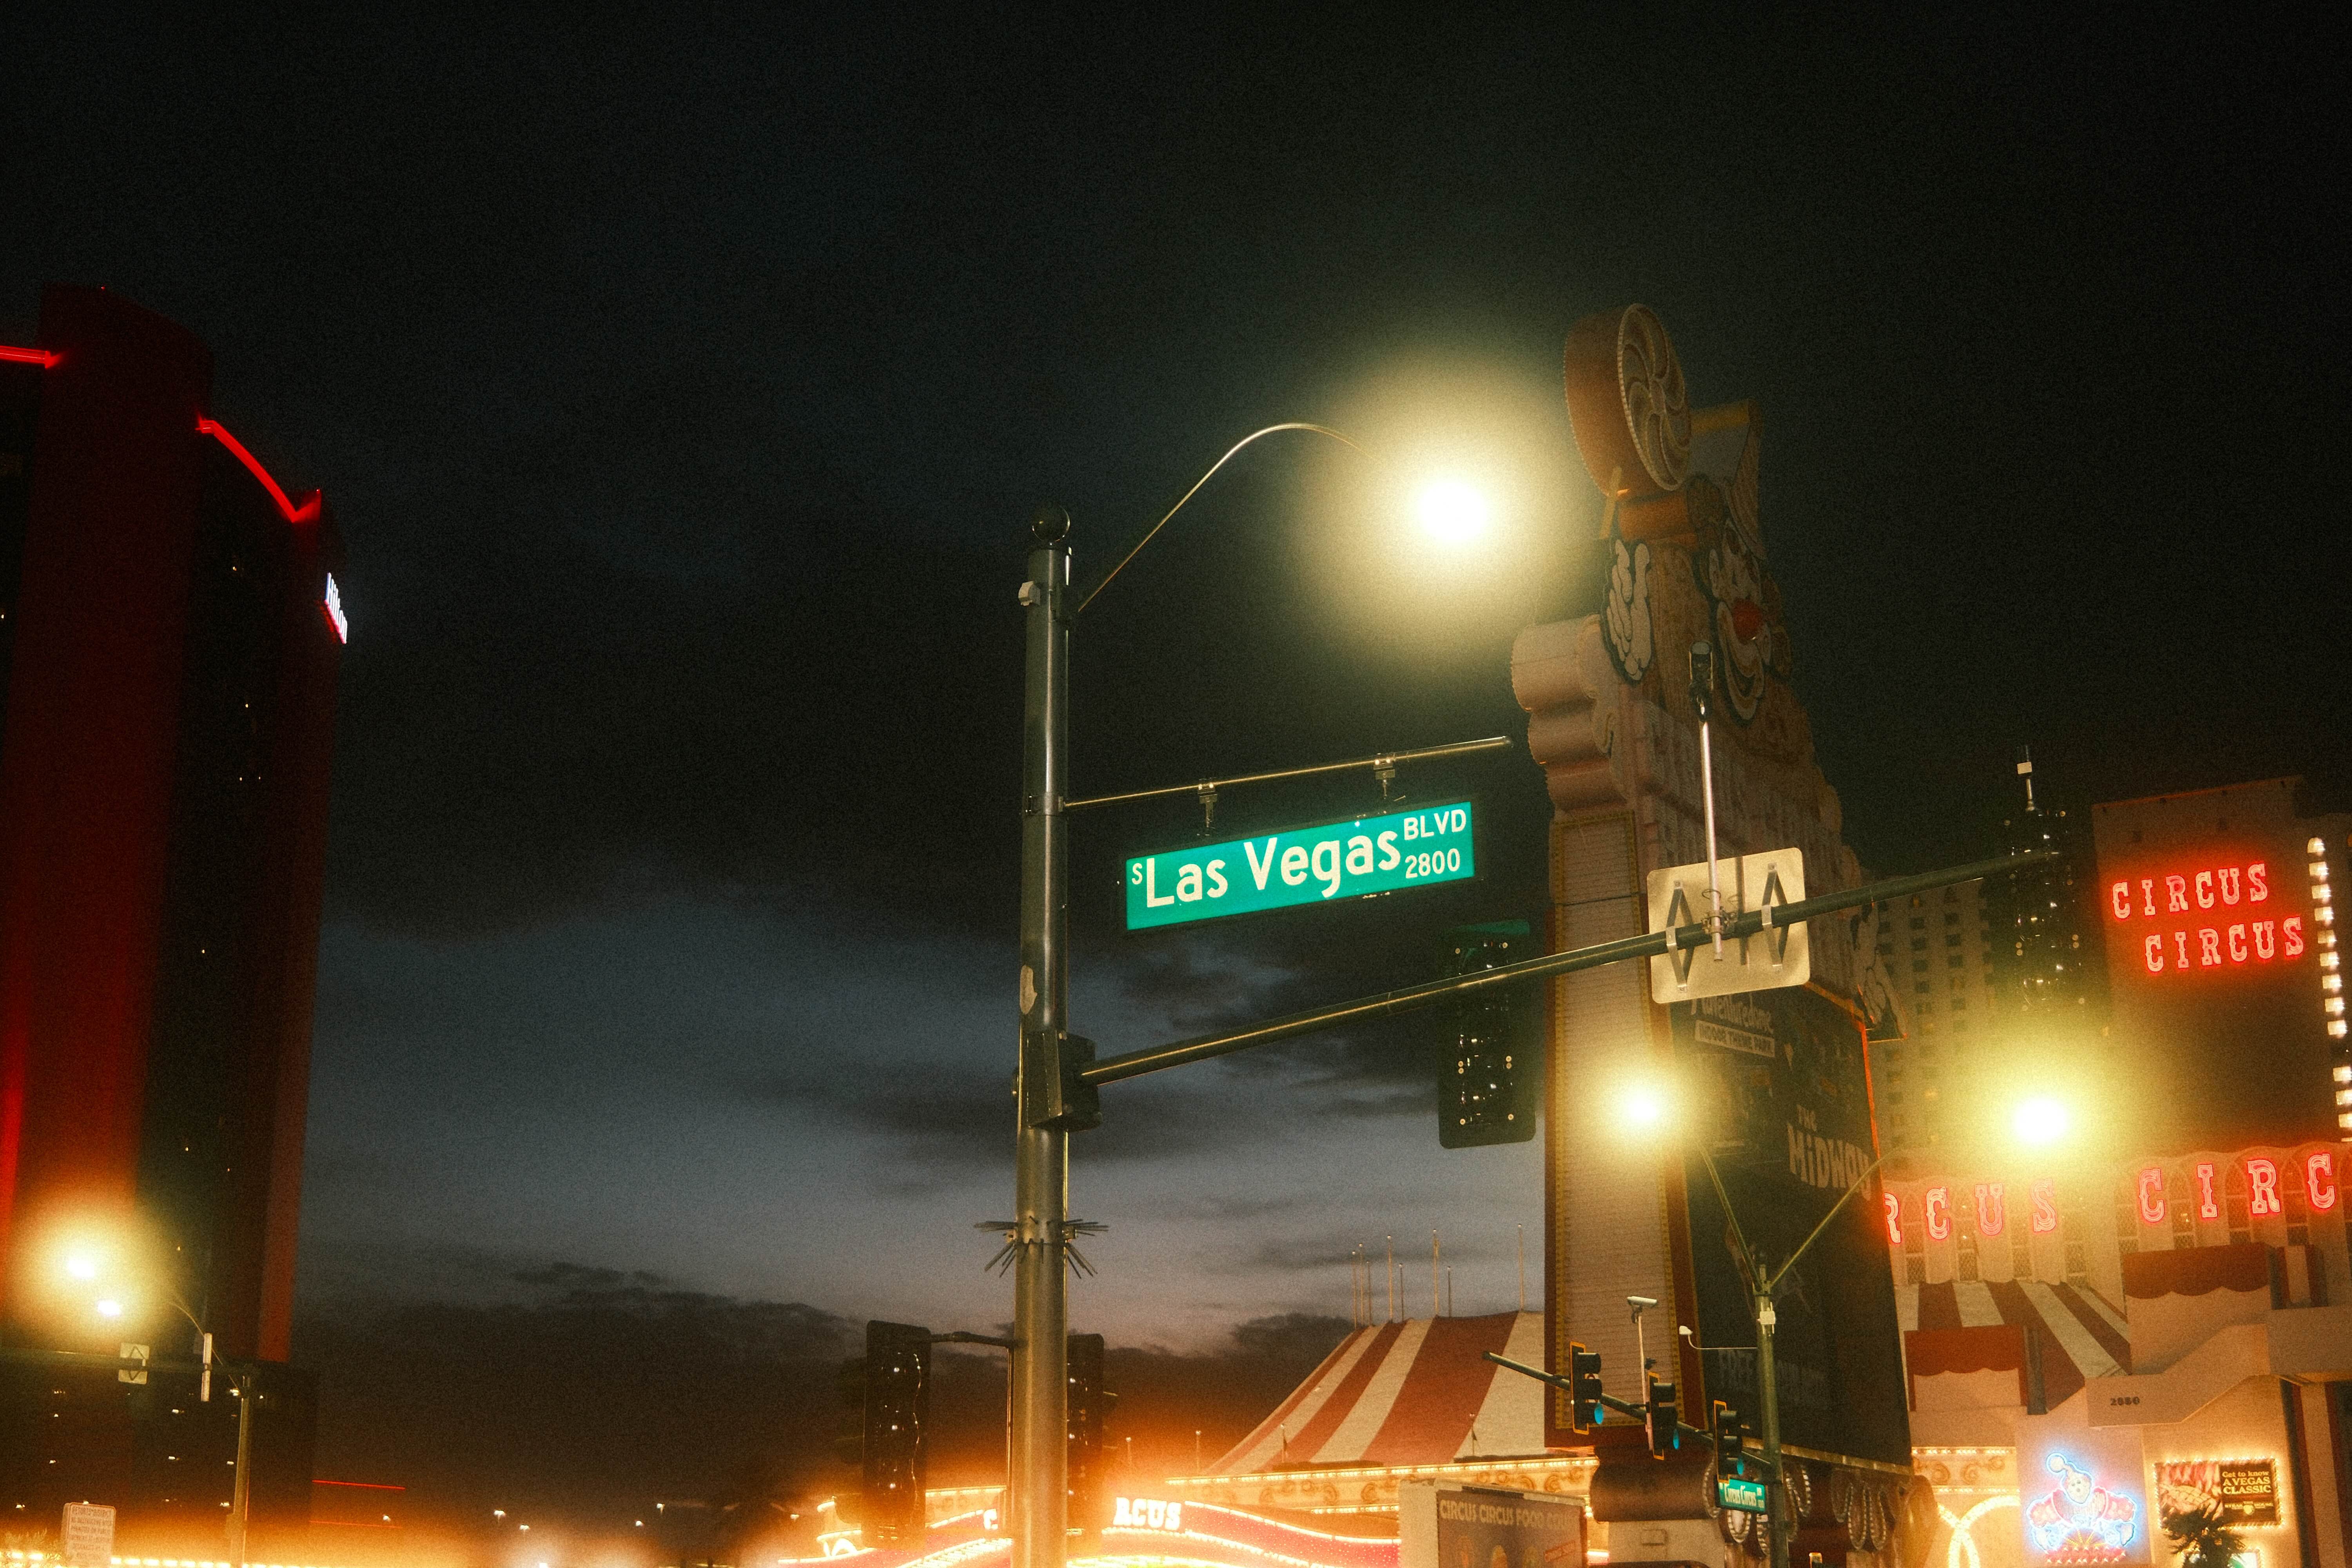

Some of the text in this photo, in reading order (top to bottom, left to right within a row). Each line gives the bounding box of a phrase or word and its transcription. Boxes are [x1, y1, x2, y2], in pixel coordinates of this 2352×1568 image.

[1131, 809, 1466, 908] S Las Vegas BLVD
[1405, 848, 1460, 879] 2800
[2112, 863, 2268, 919] CIRCUS
[2145, 916, 2303, 972] CIRCUS
[1740, 1485, 1757, 1506] Circus
[2223, 1477, 2270, 1486] A VEGAS
[2223, 1485, 2271, 1494] CLASSIC
[1440, 1500, 1477, 1523] CIRCUS
[1479, 1504, 1514, 1526] CIRCUS
